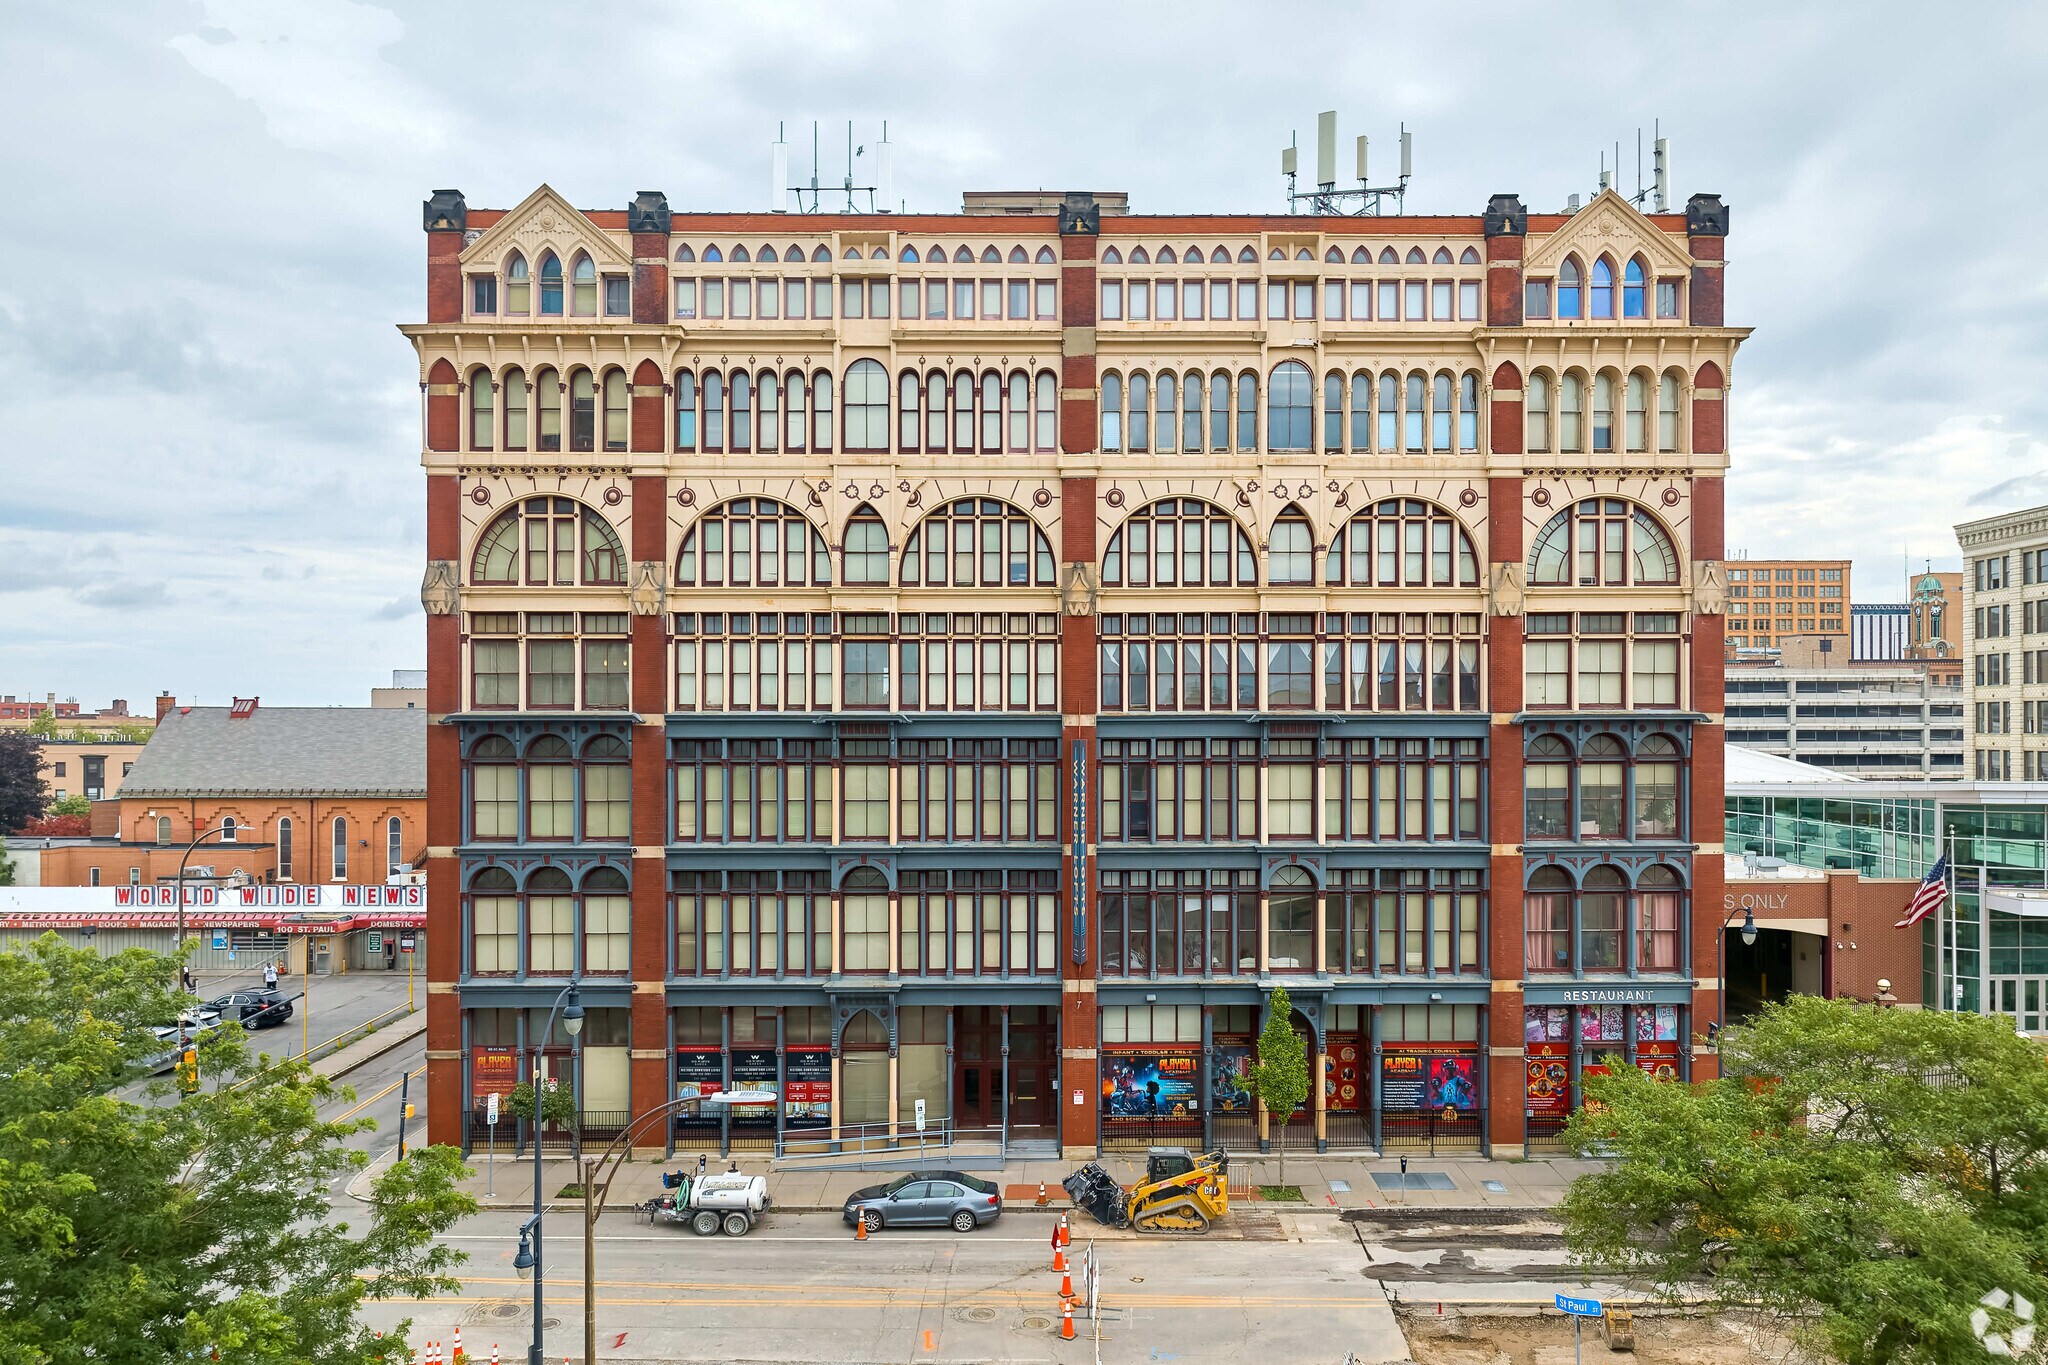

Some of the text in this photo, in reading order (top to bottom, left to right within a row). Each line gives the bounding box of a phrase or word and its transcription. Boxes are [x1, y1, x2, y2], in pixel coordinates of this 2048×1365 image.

[118, 888, 418, 904] WORLD WIDE NEWS
[1741, 894, 1788, 909] ONLY
[1563, 990, 1654, 1002] RESTAURANT
[477, 1055, 511, 1069] PLAYER
[1159, 1058, 1197, 1071] PLAYER 1
[1384, 1057, 1422, 1070] PLAYER 1
[1559, 1298, 1567, 1309] St
[1568, 1302, 1587, 1312] Paul
